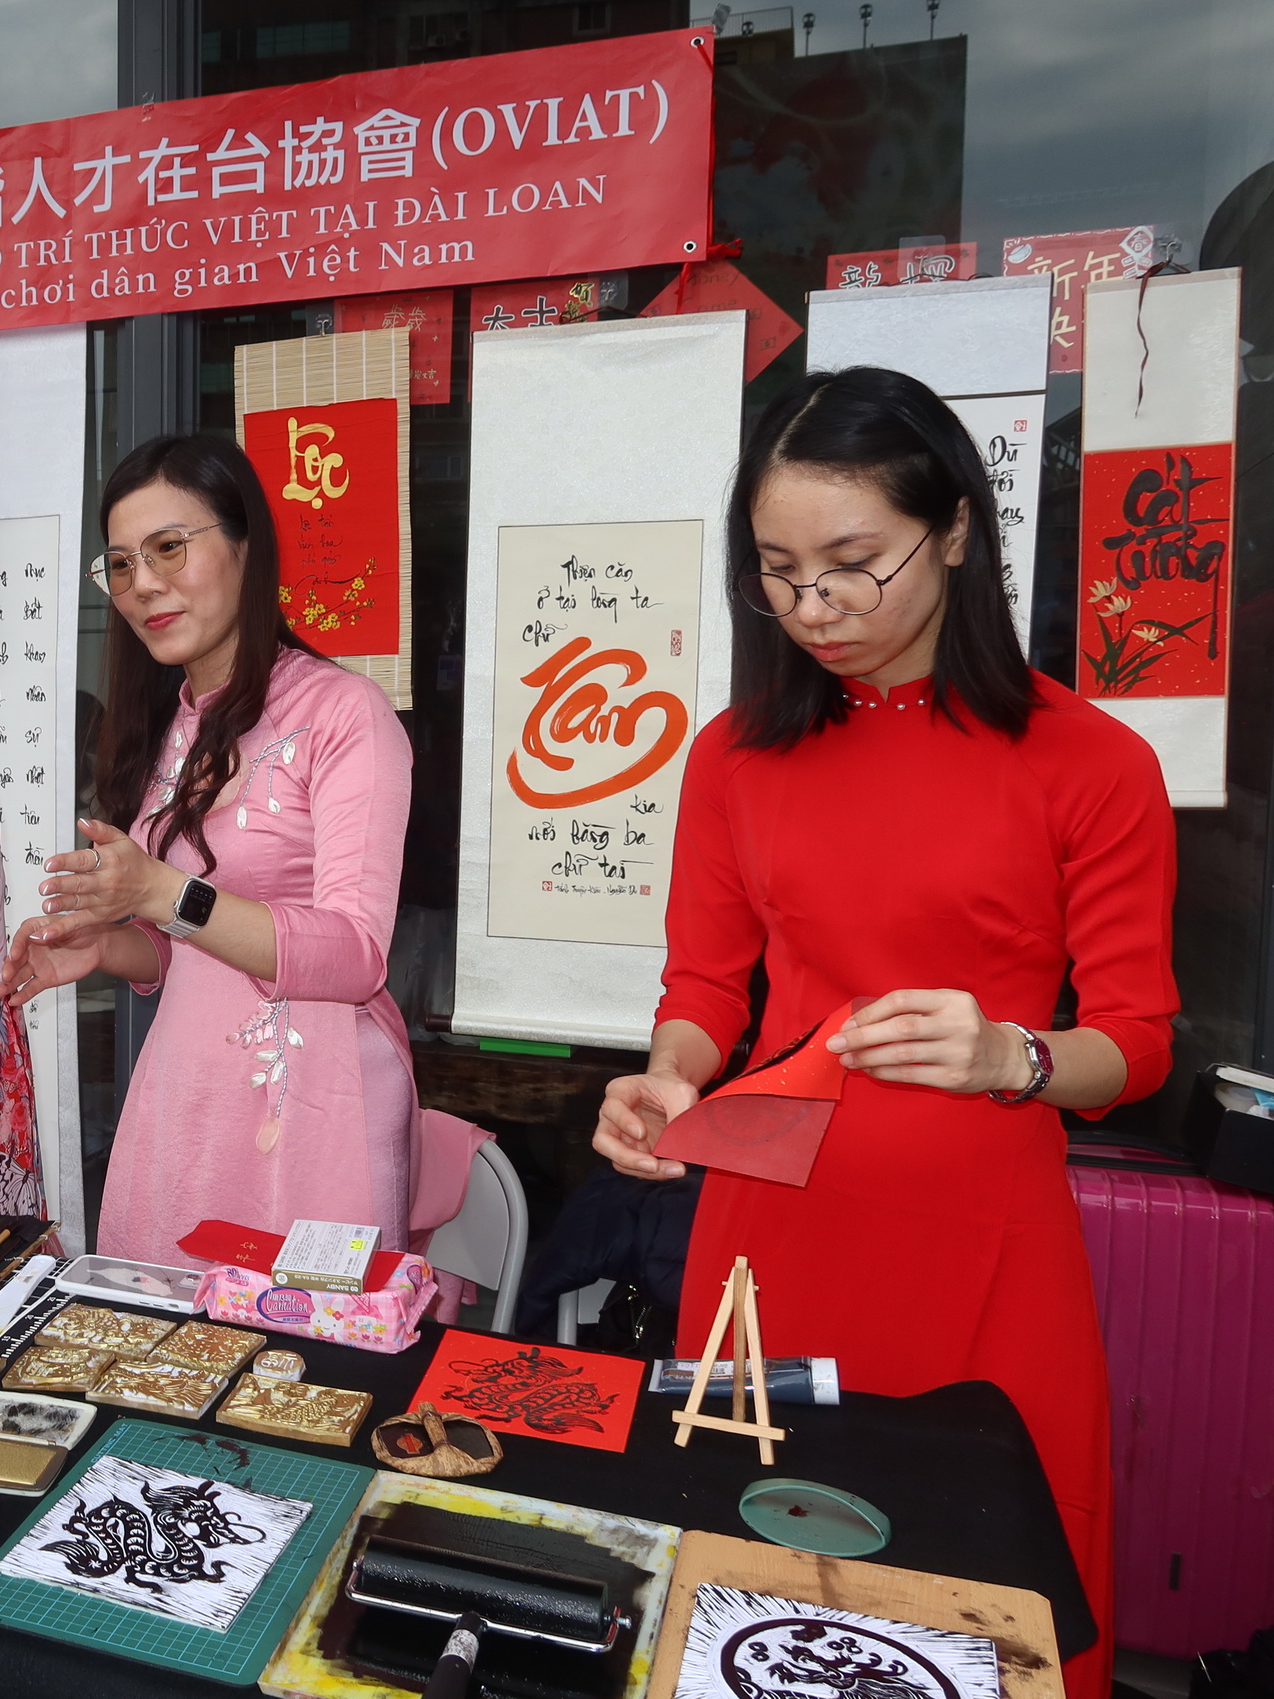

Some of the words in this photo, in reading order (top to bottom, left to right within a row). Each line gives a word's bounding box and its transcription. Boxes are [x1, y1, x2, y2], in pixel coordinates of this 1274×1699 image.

[14, 232, 73, 268] TRÍ
[85, 217, 189, 260] THỨC
[203, 208, 296, 250] VIỆT
[311, 201, 377, 239] TẠI
[394, 187, 467, 223] ĐÀI
[484, 175, 606, 216] LOAN
[0, 273, 74, 309] chơi
[91, 262, 157, 298] dân
[174, 257, 259, 297] gian
[277, 244, 359, 282] Việt
[379, 240, 475, 269] Nam
[631, 586, 664, 609] ta
[625, 820, 654, 846] ba
[90, 1437, 116, 1463] CUTTING
[114, 1423, 128, 1437] MAT
